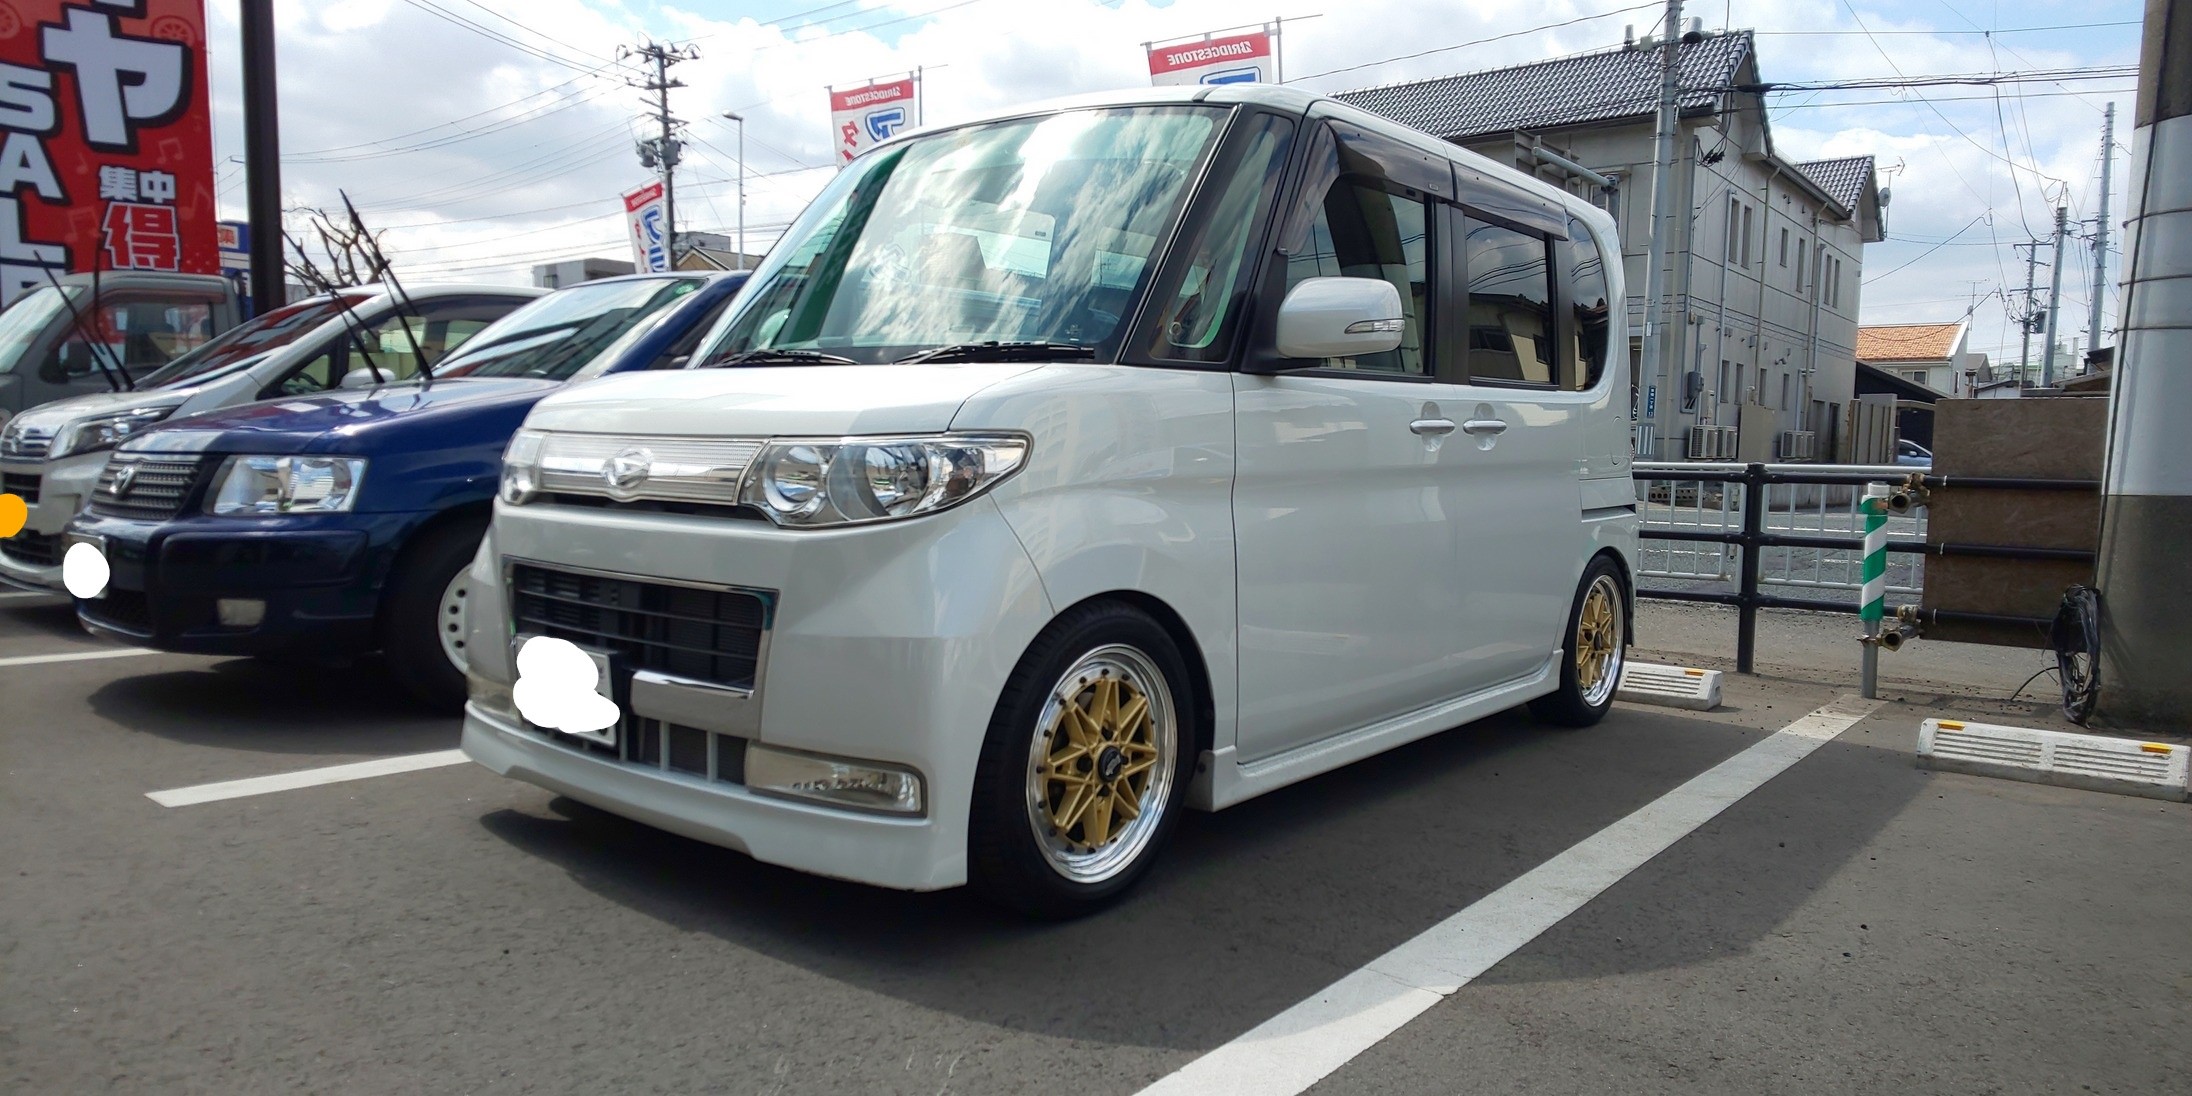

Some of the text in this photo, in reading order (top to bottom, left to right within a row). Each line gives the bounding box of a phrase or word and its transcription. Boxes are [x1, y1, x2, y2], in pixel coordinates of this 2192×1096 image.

[43, 0, 183, 146] ヤ
[99, 165, 176, 203] 集中
[102, 201, 181, 271] 得
